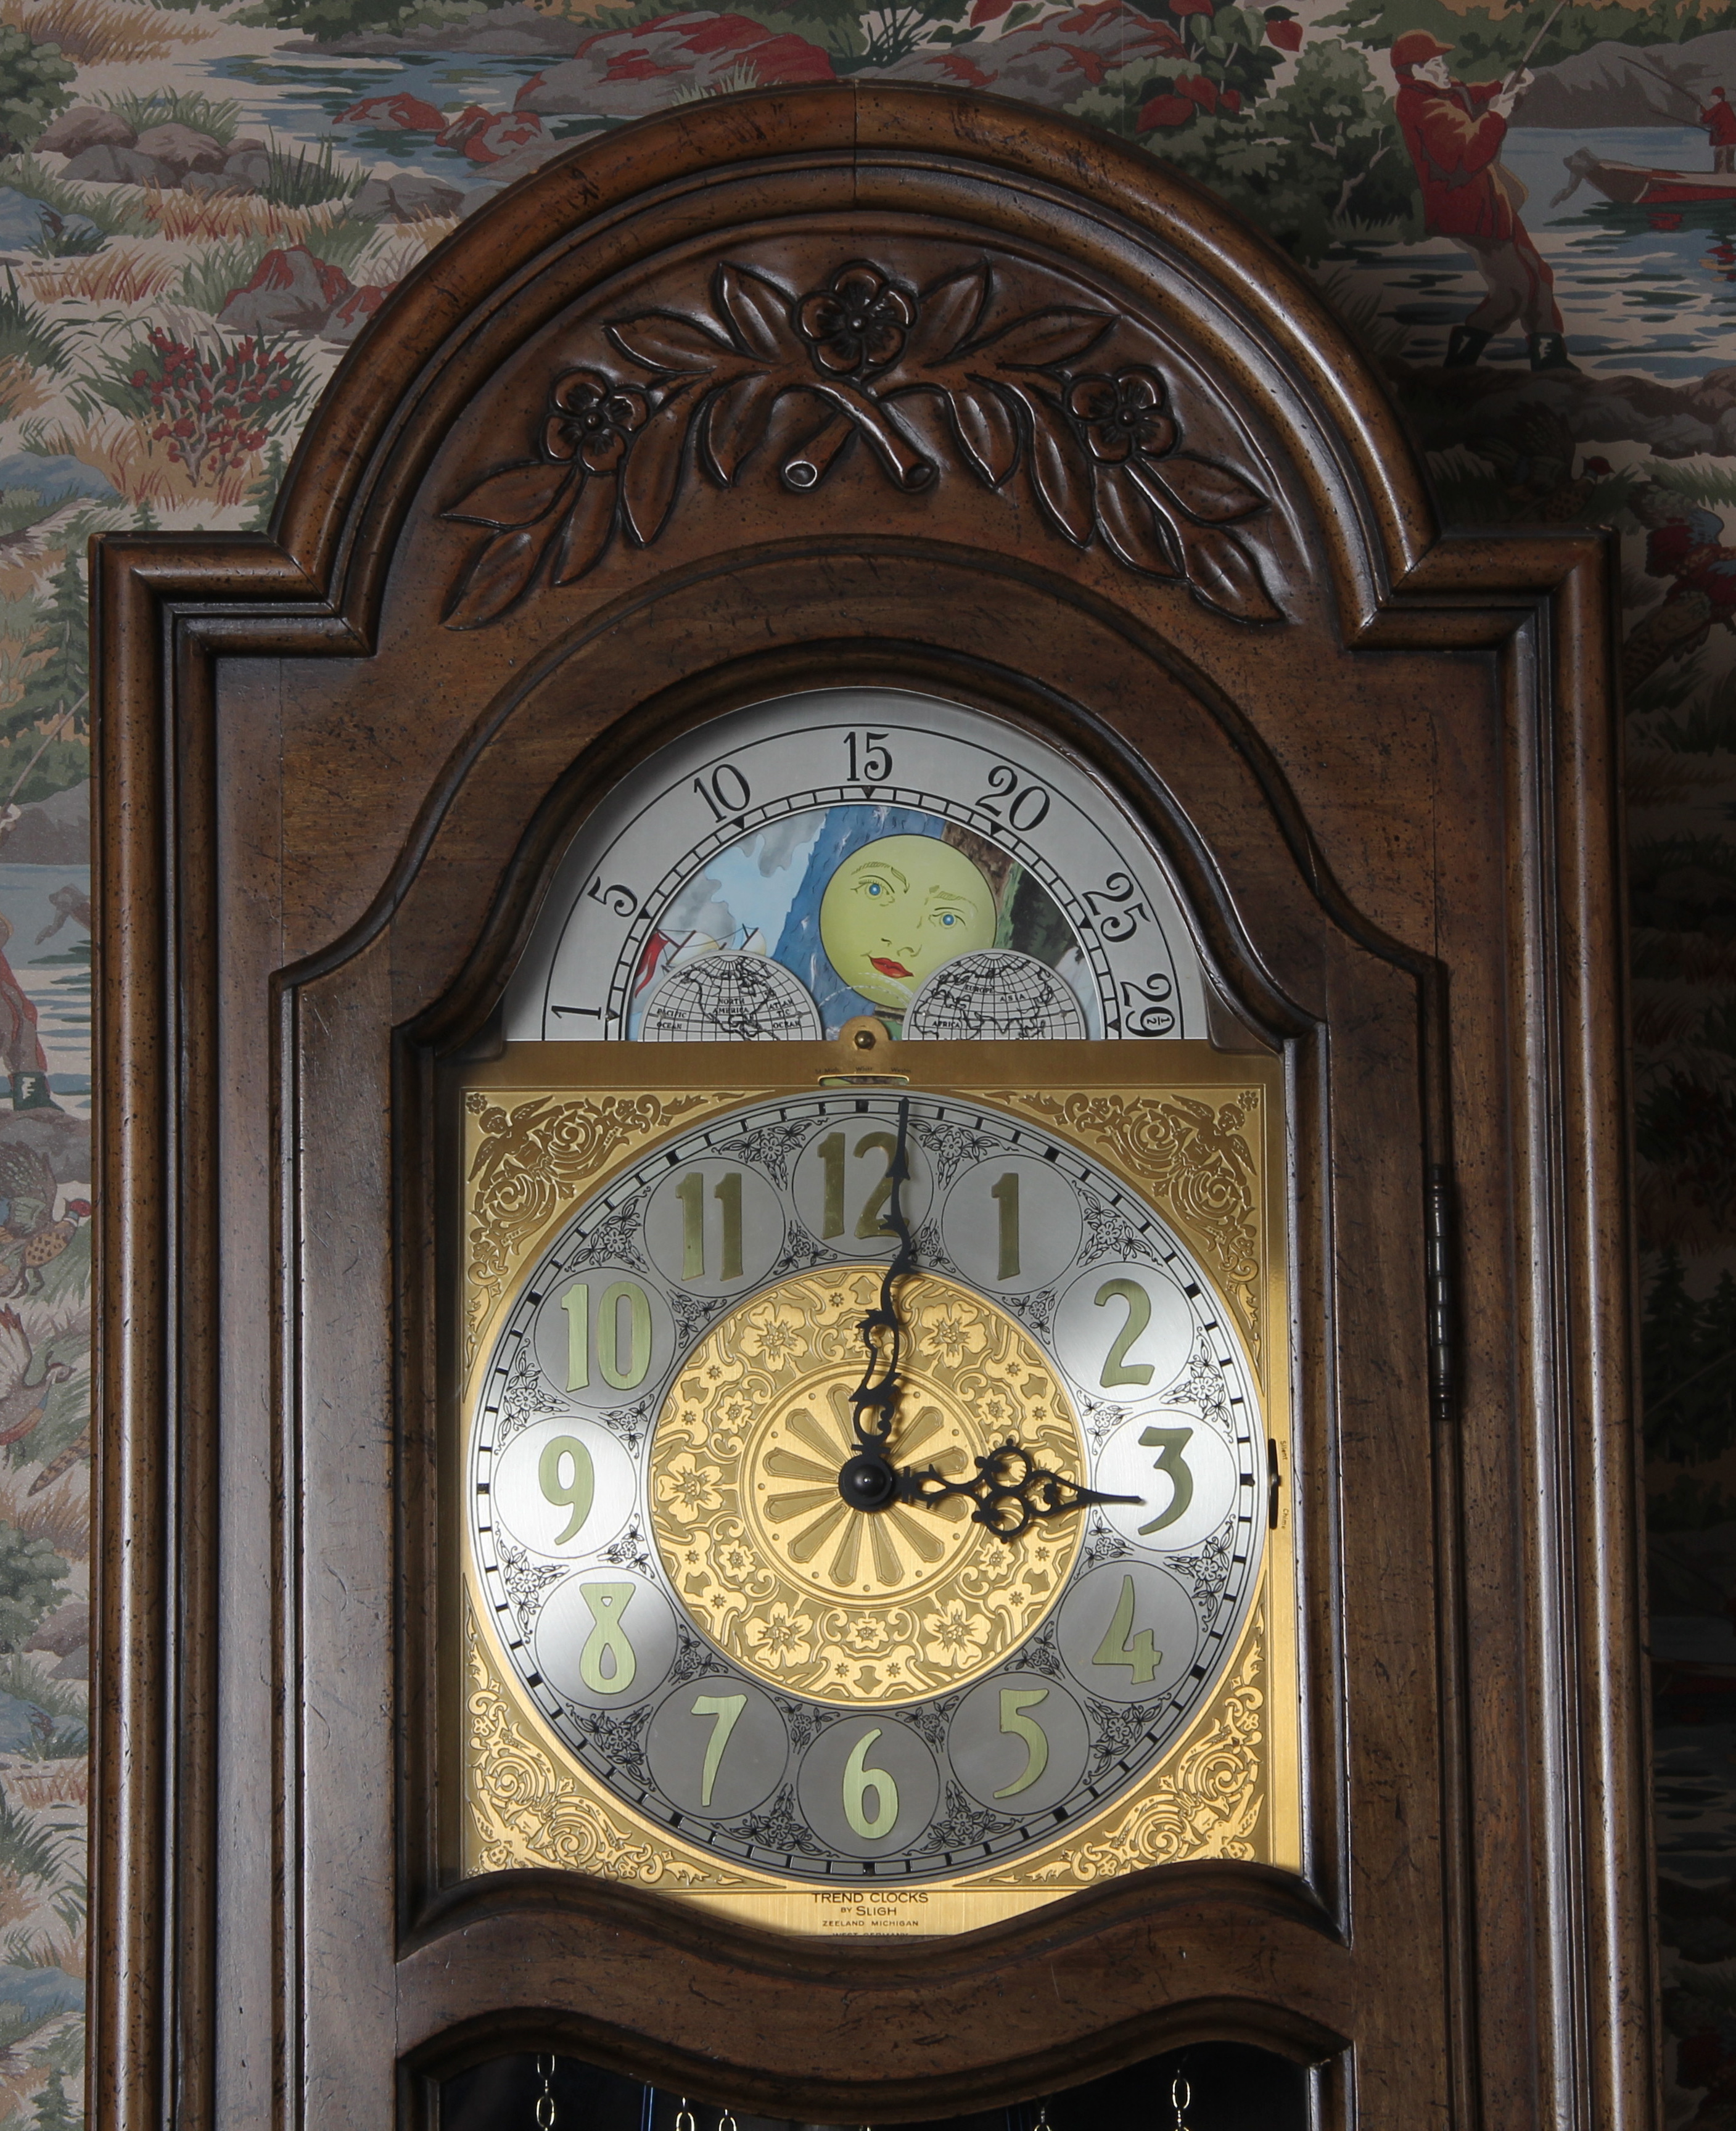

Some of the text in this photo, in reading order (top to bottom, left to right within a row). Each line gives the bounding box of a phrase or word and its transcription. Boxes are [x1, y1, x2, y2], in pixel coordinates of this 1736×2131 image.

[693, 764, 751, 823] 10
[843, 731, 894, 782] 15
[976, 765, 1050, 832] 20
[587, 876, 638, 917] 5
[1082, 872, 1151, 942] 25
[551, 1005, 602, 1020] 1
[657, 1021, 682, 1029] OCEAN
[1000, 993, 1025, 1001] ASIA
[1120, 973, 1175, 1037] 29
[675, 1172, 744, 1281] 11
[817, 1131, 910, 1241] 12
[991, 1172, 1021, 1281] 1
[561, 1281, 652, 1392] 10
[1094, 1278, 1154, 1388] 2
[538, 1435, 594, 1545] 9
[1137, 1426, 1193, 1535] 3
[579, 1582, 636, 1694] 8
[1092, 1574, 1163, 1685] 4
[690, 1694, 748, 1807] 7
[842, 1728, 899, 1840] 6
[992, 1688, 1049, 1798] 5
[812, 1892, 929, 1903] TREND CLOCKS
